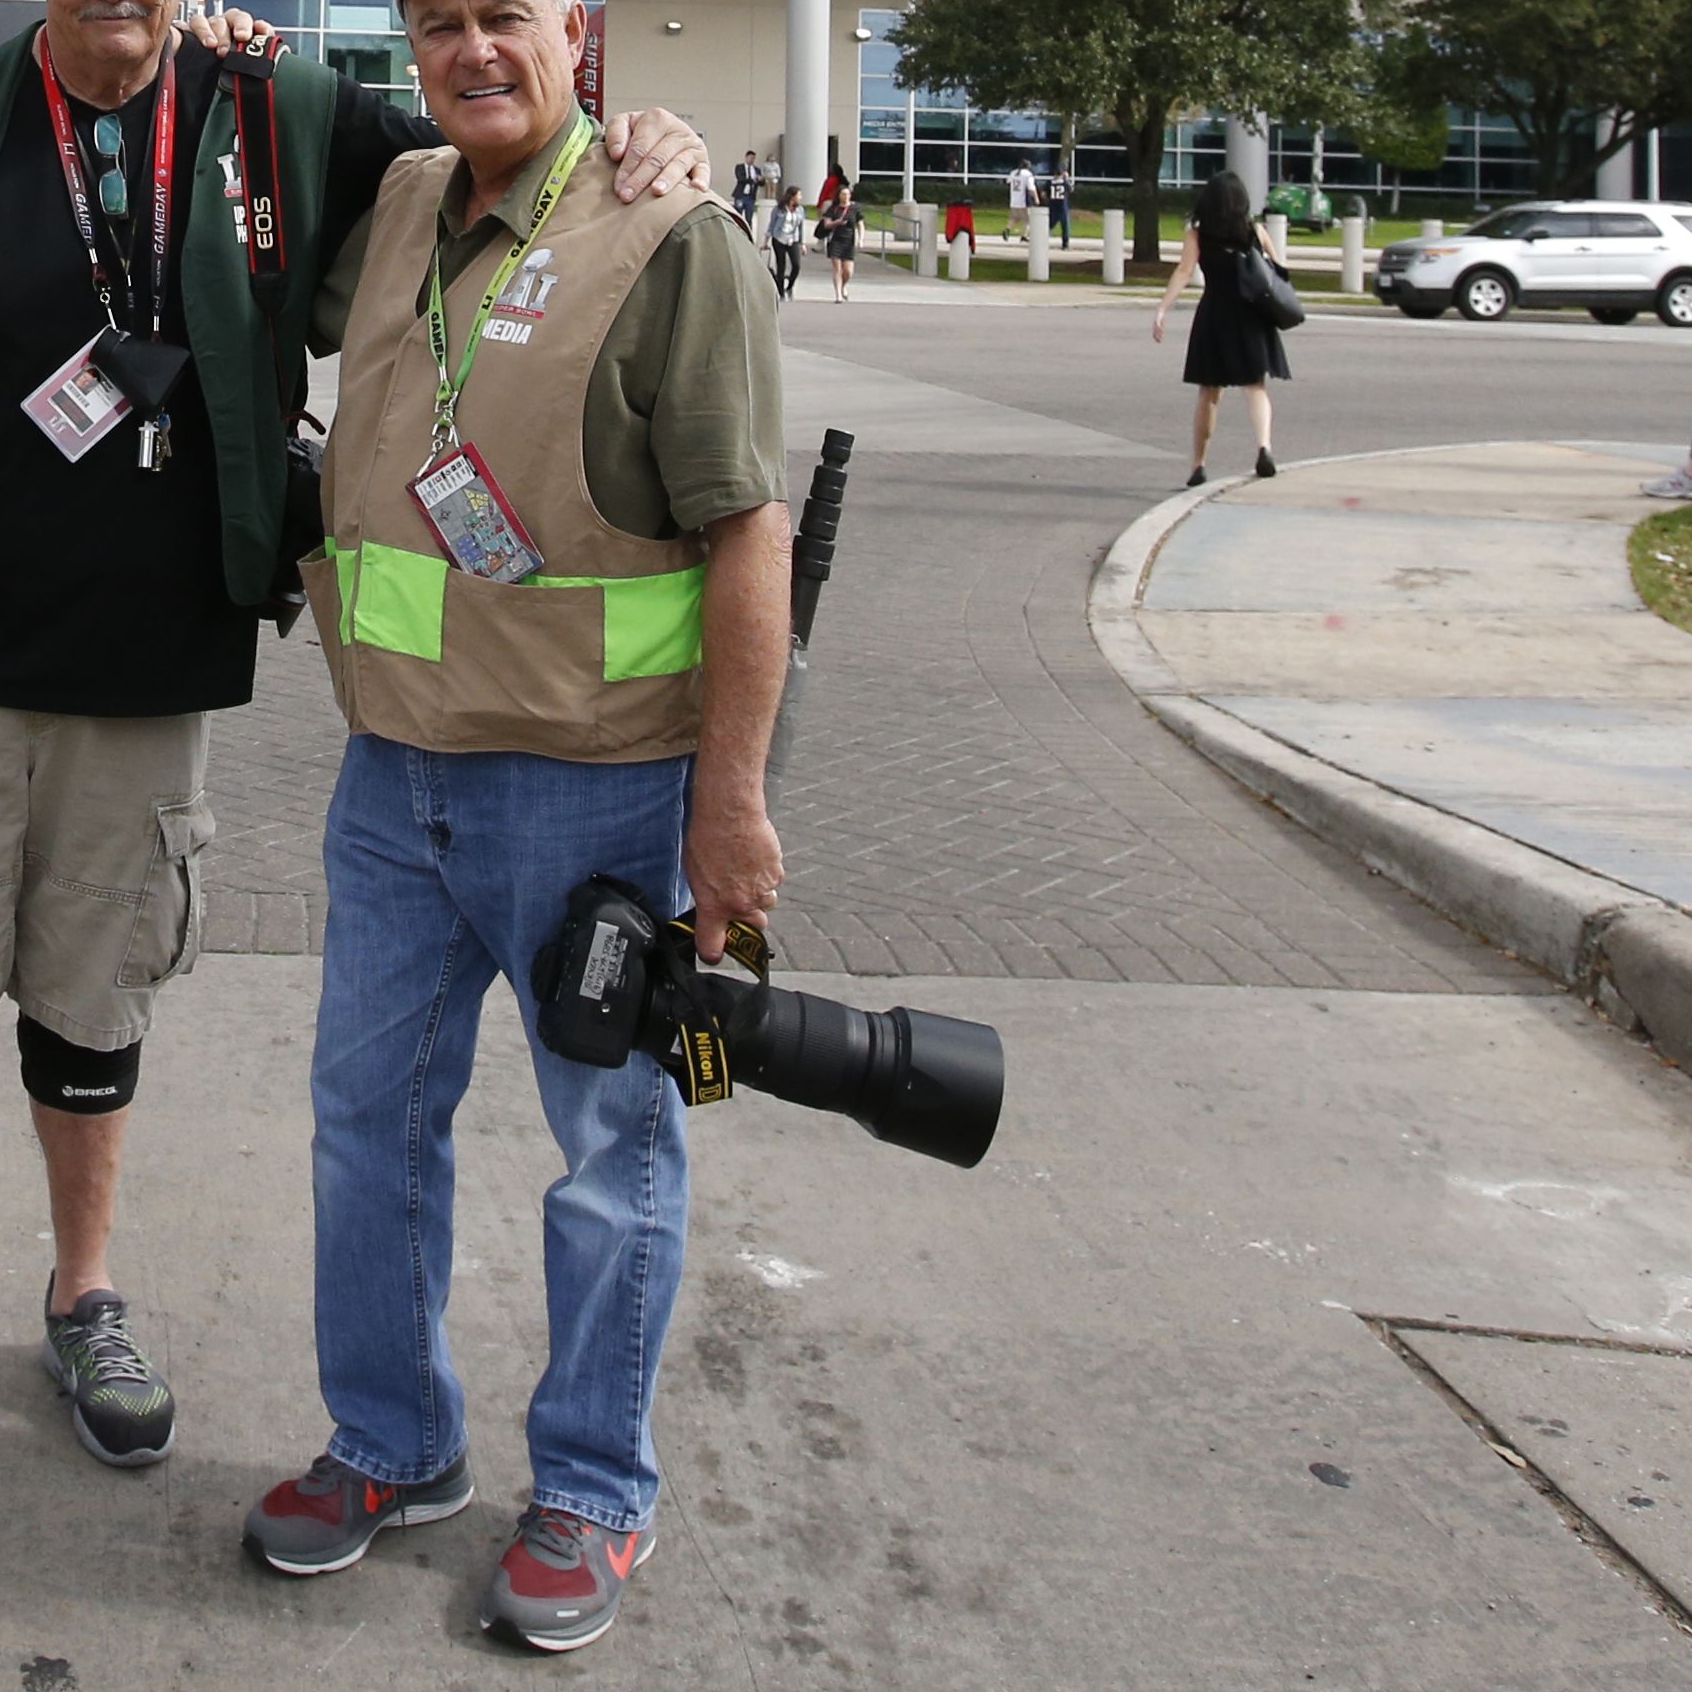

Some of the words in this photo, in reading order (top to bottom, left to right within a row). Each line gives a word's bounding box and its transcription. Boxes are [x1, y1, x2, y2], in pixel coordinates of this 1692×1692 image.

[584, 32, 598, 93] SUPER
[153, 182, 168, 254] GAMEDAY
[1050, 185, 1065, 199] 12
[254, 196, 274, 250] EOS
[510, 189, 555, 259] GAEDAY
[695, 1032, 714, 1081] Nikon
[74, 1086, 115, 1096] BREG
